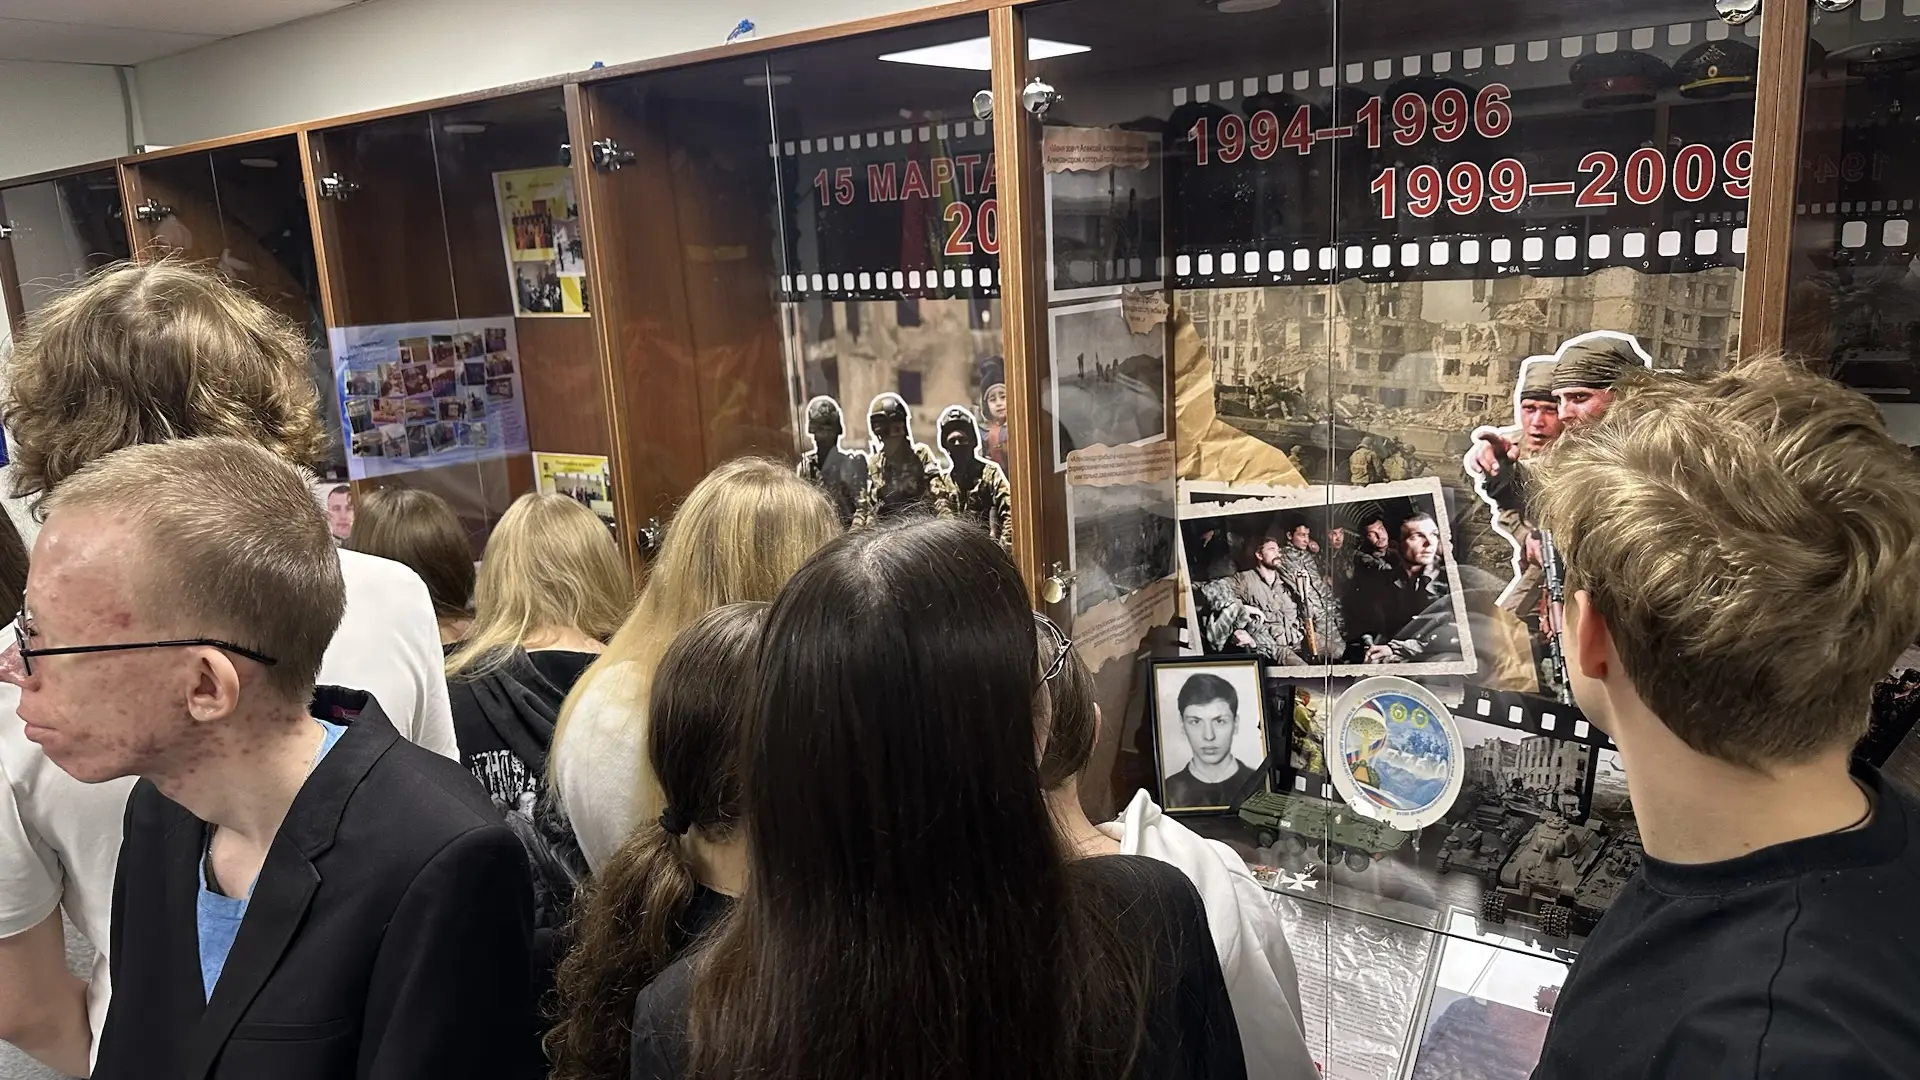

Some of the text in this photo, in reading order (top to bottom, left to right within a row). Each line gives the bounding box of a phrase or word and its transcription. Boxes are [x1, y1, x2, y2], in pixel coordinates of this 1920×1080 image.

[1187, 83, 1513, 166] 1994–1996
[814, 153, 997, 206] 15 МАРТА
[1371, 140, 1754, 219] 1999–2009
[1509, 265, 1520, 273] 8A
[1643, 260, 1650, 269] 9
[1864, 252, 1871, 260] 7
